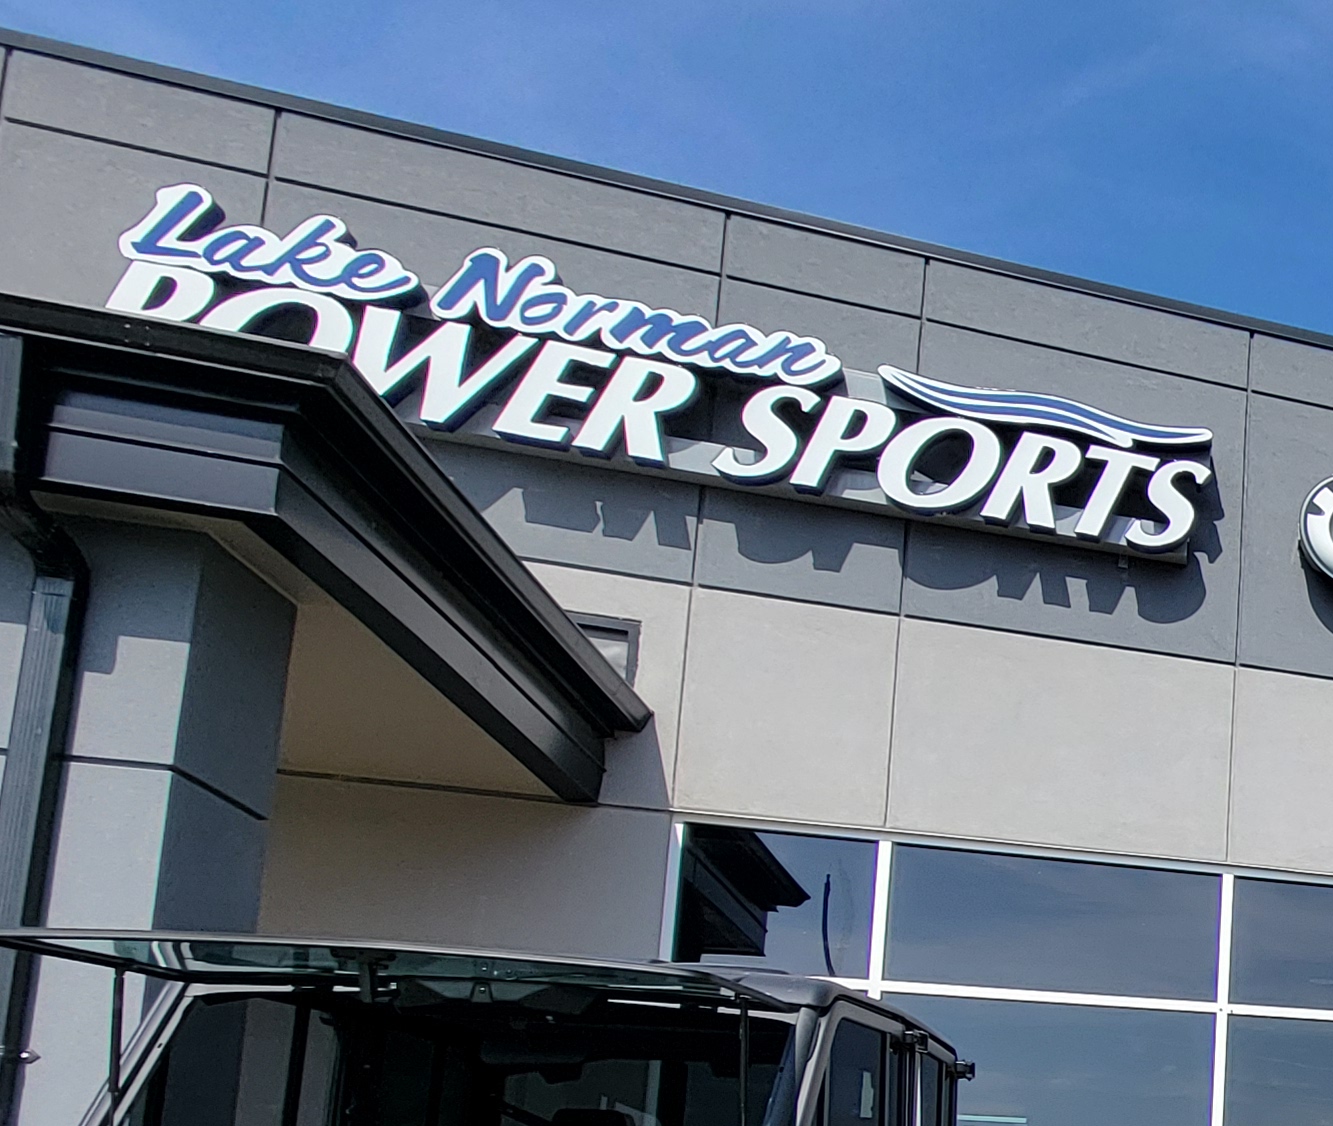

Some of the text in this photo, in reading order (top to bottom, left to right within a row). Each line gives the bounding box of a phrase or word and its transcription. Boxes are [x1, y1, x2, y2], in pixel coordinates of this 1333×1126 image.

[121, 184, 840, 384] Lake Norman
[712, 384, 1212, 554] SPORTS
